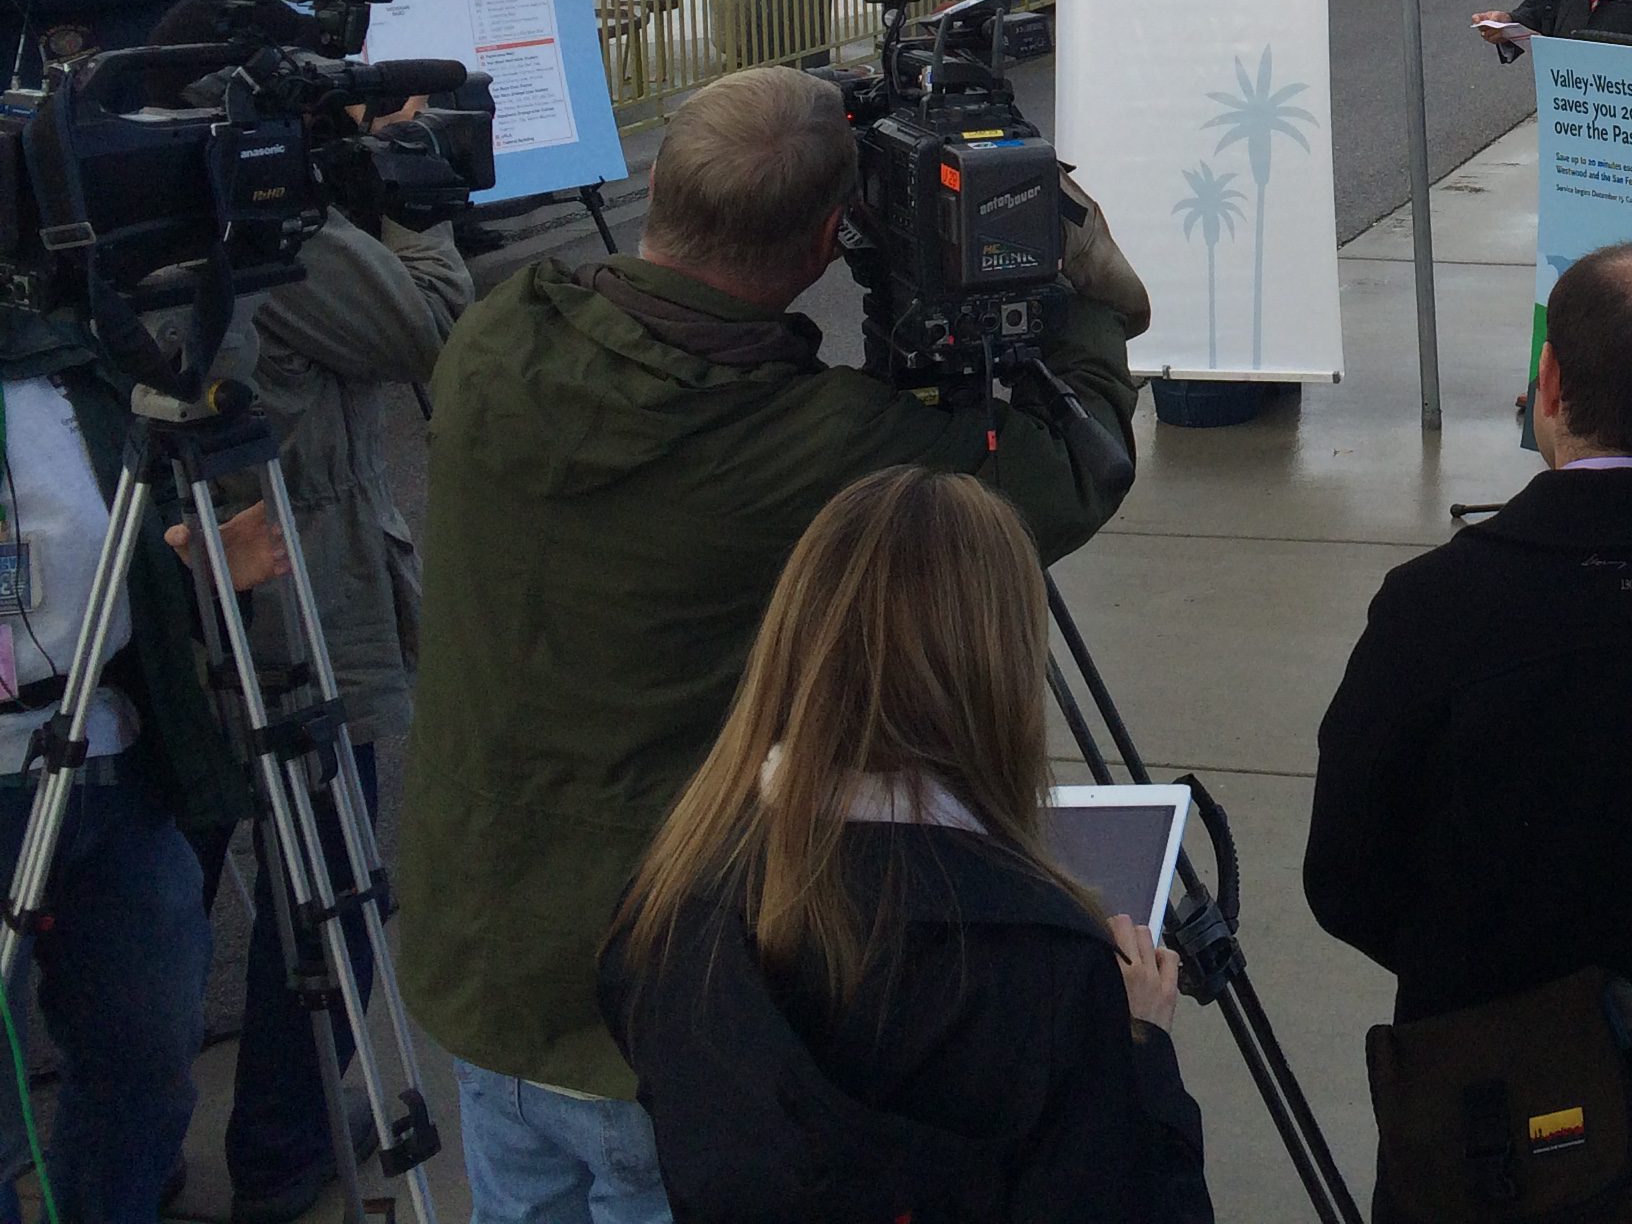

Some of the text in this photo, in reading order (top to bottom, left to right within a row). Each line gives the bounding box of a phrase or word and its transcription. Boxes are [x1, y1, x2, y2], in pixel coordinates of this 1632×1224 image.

[1553, 96, 1589, 115] saves
[1592, 102, 1616, 121] you
[1554, 120, 1583, 137] over
[1587, 120, 1609, 141] the
[241, 144, 285, 158] anasonic
[1556, 152, 1569, 162] Save
[1571, 157, 1579, 165] up
[1580, 157, 1586, 165] to
[1598, 159, 1622, 170] minutes
[1556, 165, 1587, 178] Westwood
[1589, 171, 1599, 180] and
[1612, 174, 1623, 184] San
